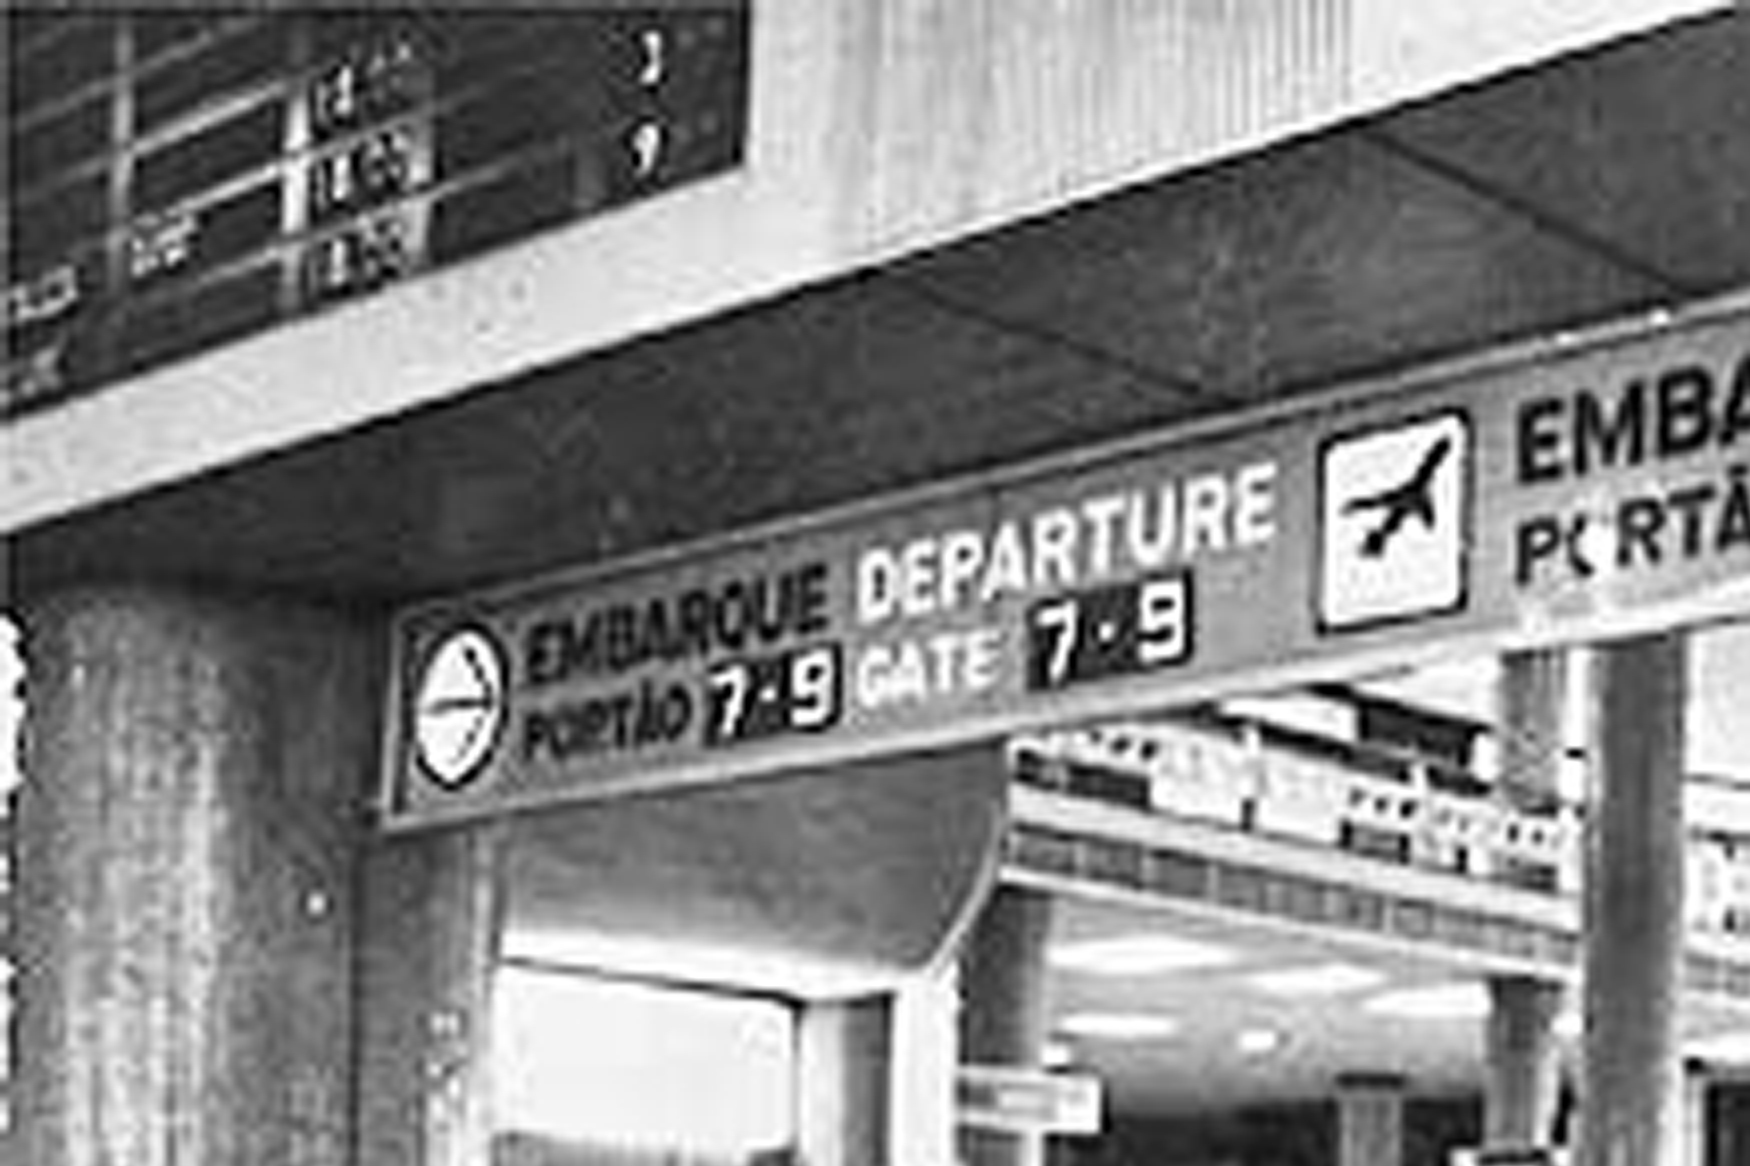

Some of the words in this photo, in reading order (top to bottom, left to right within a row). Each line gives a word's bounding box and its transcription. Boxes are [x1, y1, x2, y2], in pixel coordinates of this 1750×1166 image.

[856, 462, 1278, 622] DEPARTURE
[526, 562, 830, 684] EMBARQUE
[855, 630, 1002, 710] GATE
[524, 676, 692, 762] PORTÃO
